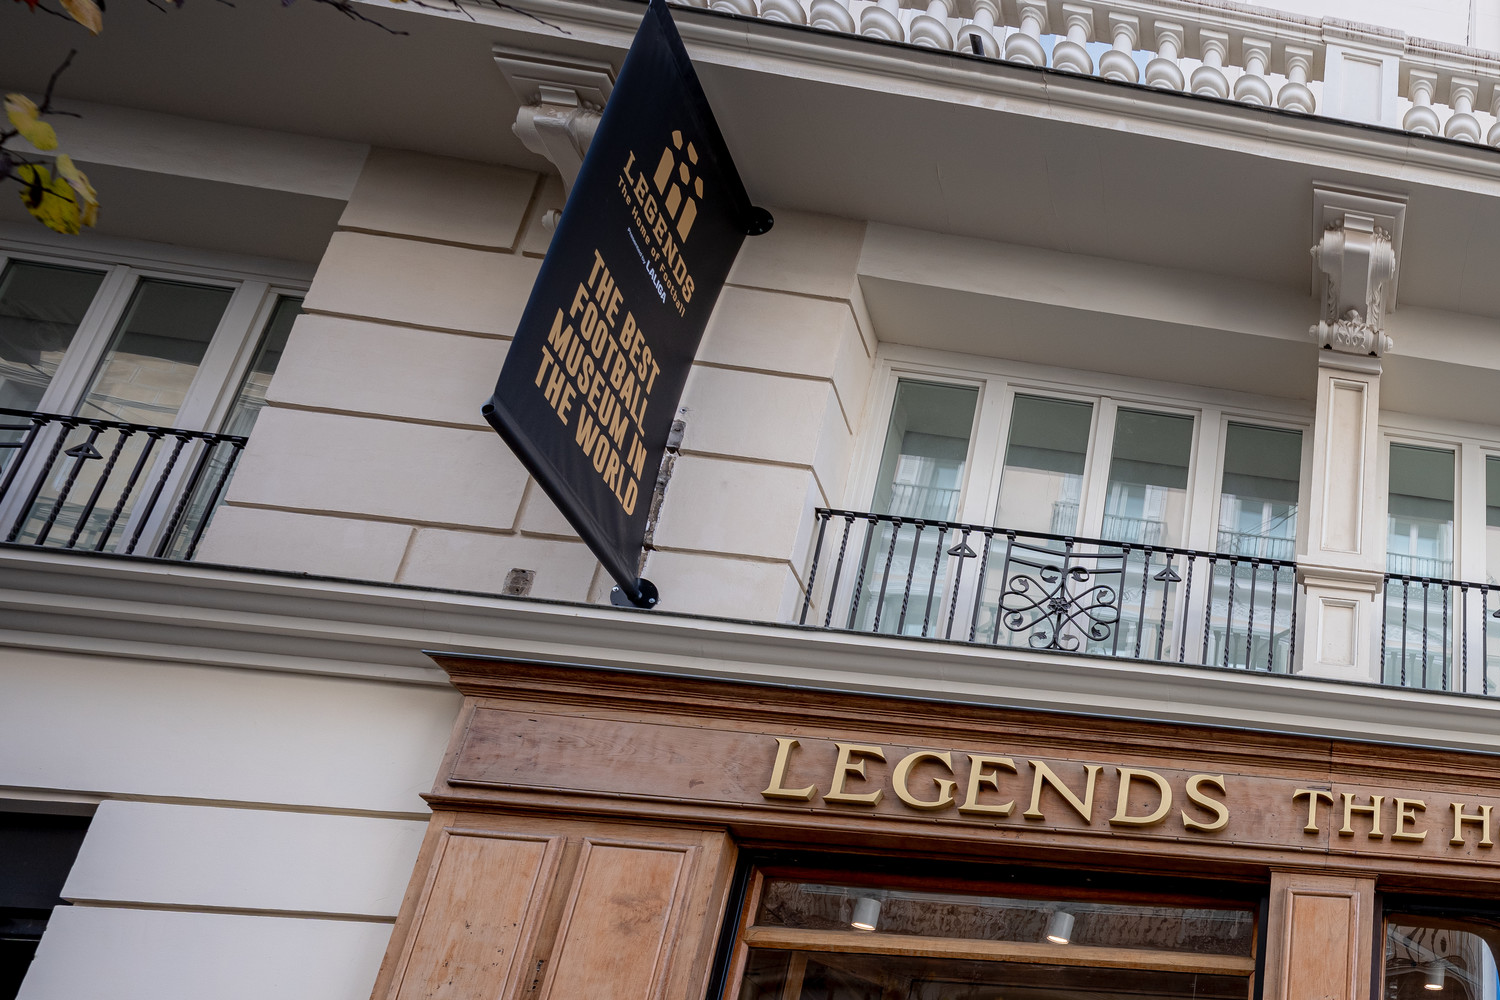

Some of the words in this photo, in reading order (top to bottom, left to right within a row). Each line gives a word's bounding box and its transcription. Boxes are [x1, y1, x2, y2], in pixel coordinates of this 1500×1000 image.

[617, 175, 631, 206] The
[632, 206, 651, 245] Home
[651, 249, 661, 262] of
[660, 263, 686, 317] Football
[623, 150, 695, 303] LEGENDS
[645, 259, 667, 304] LALIGA
[547, 307, 629, 449] MUSEUM
[627, 431, 648, 481] IN
[569, 282, 648, 438] FOOTBALL
[587, 248, 624, 328] THE
[620, 311, 660, 395] BEST
[535, 345, 577, 426] THE
[575, 404, 639, 516] WORLD
[761, 737, 1230, 832] LEGENDS
[1293, 788, 1428, 842] THE
